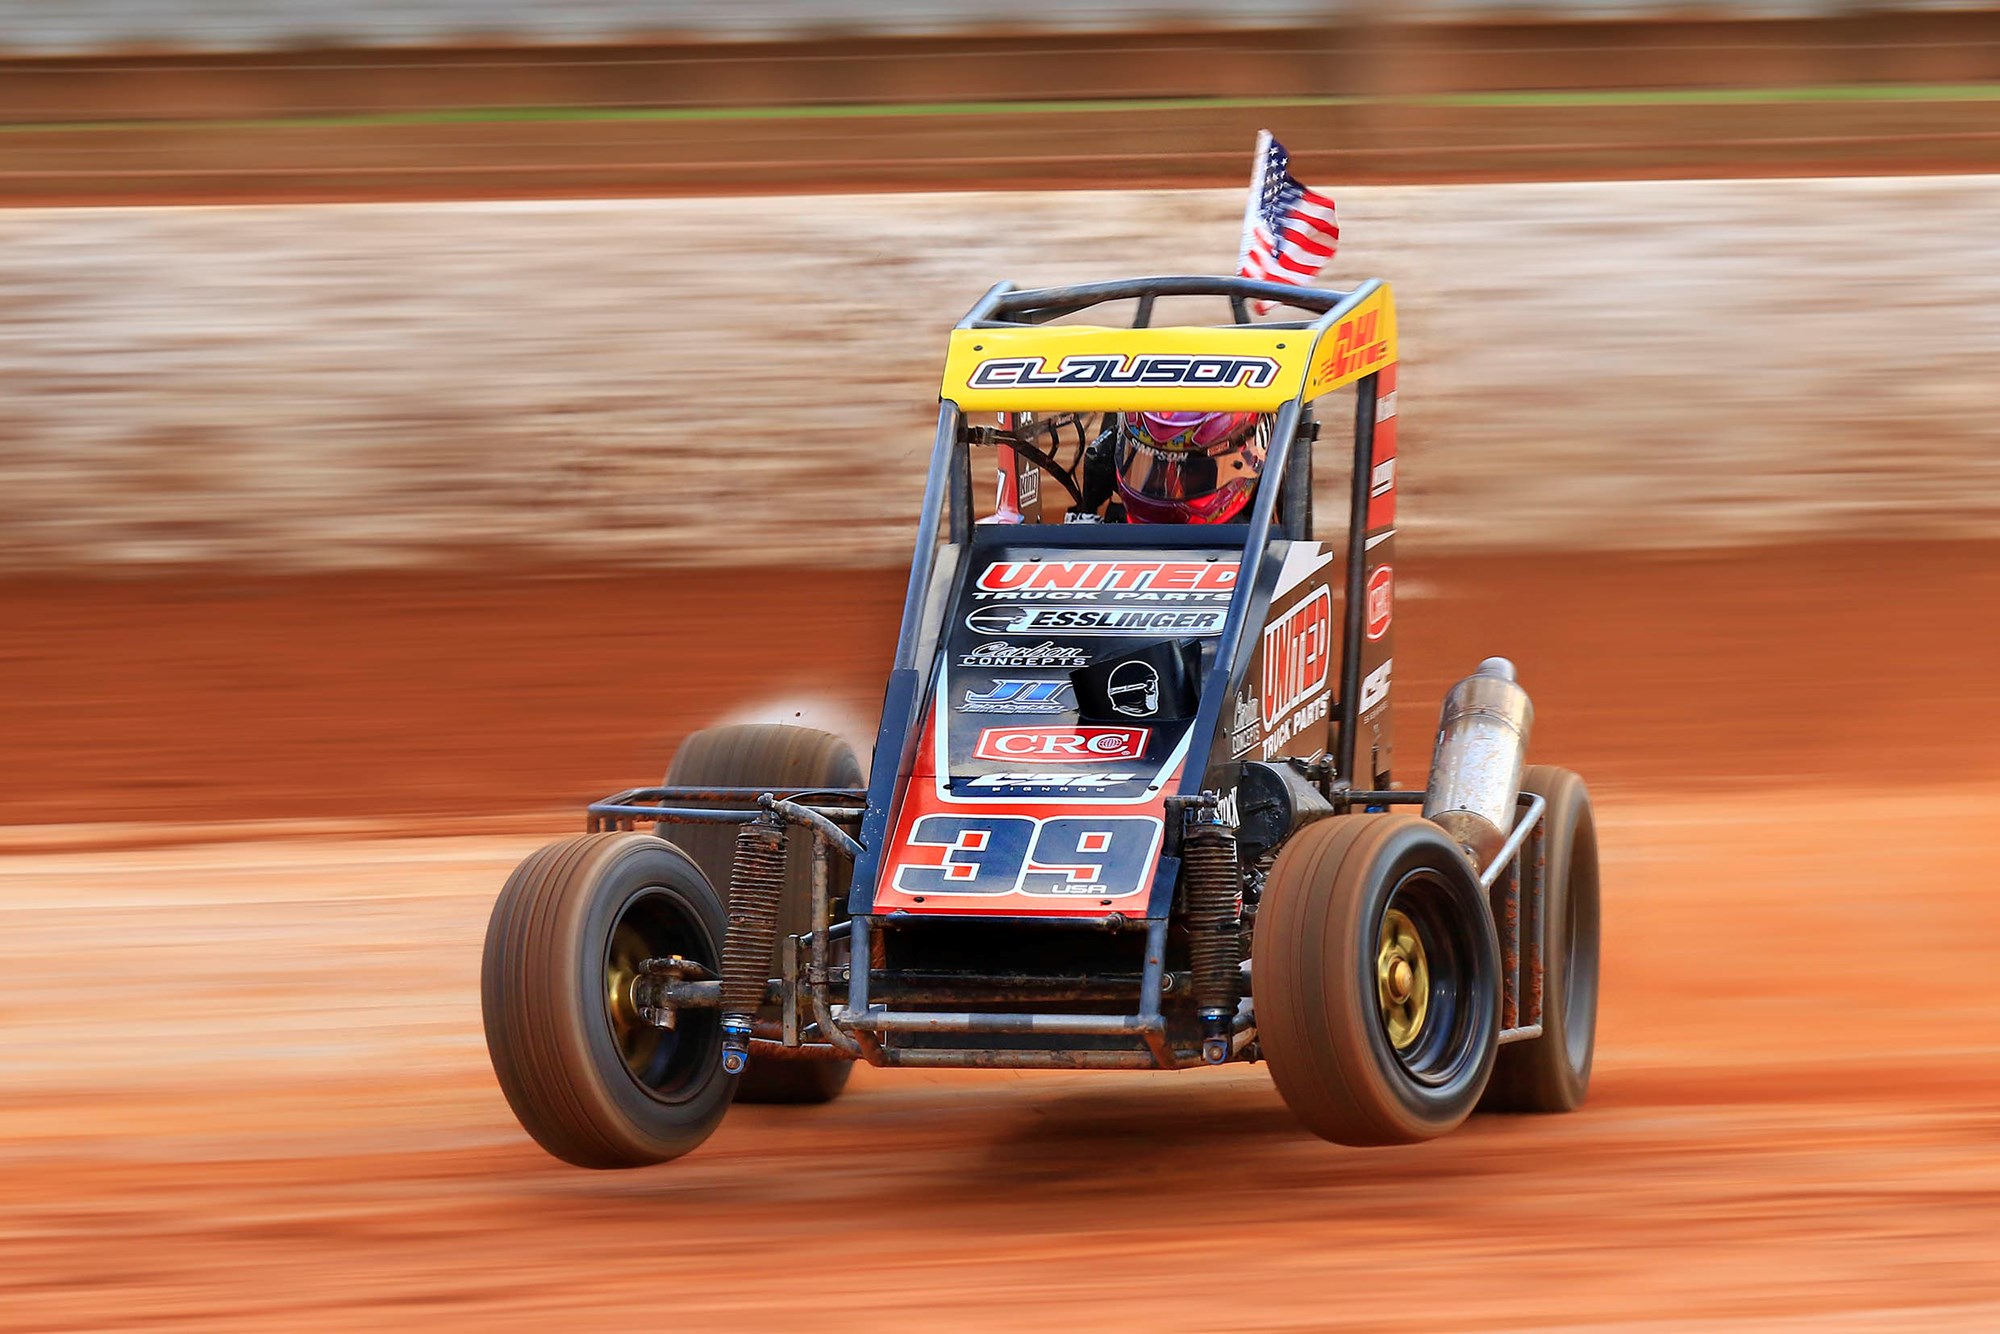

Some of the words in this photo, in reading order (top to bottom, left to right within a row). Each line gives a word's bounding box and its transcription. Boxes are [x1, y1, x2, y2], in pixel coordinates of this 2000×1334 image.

[973, 358, 1274, 385] CLAUSON
[1130, 437, 1189, 462] SIMPSON
[977, 562, 1241, 591] UNITED
[971, 591, 1102, 600] TRUCK
[1112, 592, 1235, 601] PARTS
[1030, 611, 1219, 628] ESSLINGER
[962, 656, 1087, 666] CONCEPTS
[971, 641, 1084, 657] Carbon
[1264, 589, 1330, 729] UNITED
[1231, 722, 1261, 755] CONCEPTS
[1262, 718, 1293, 761] TRUCK
[1292, 697, 1329, 736] PARTS
[994, 733, 1131, 755] CRC
[891, 813, 1165, 899] 39
[1051, 884, 1108, 894] USA
